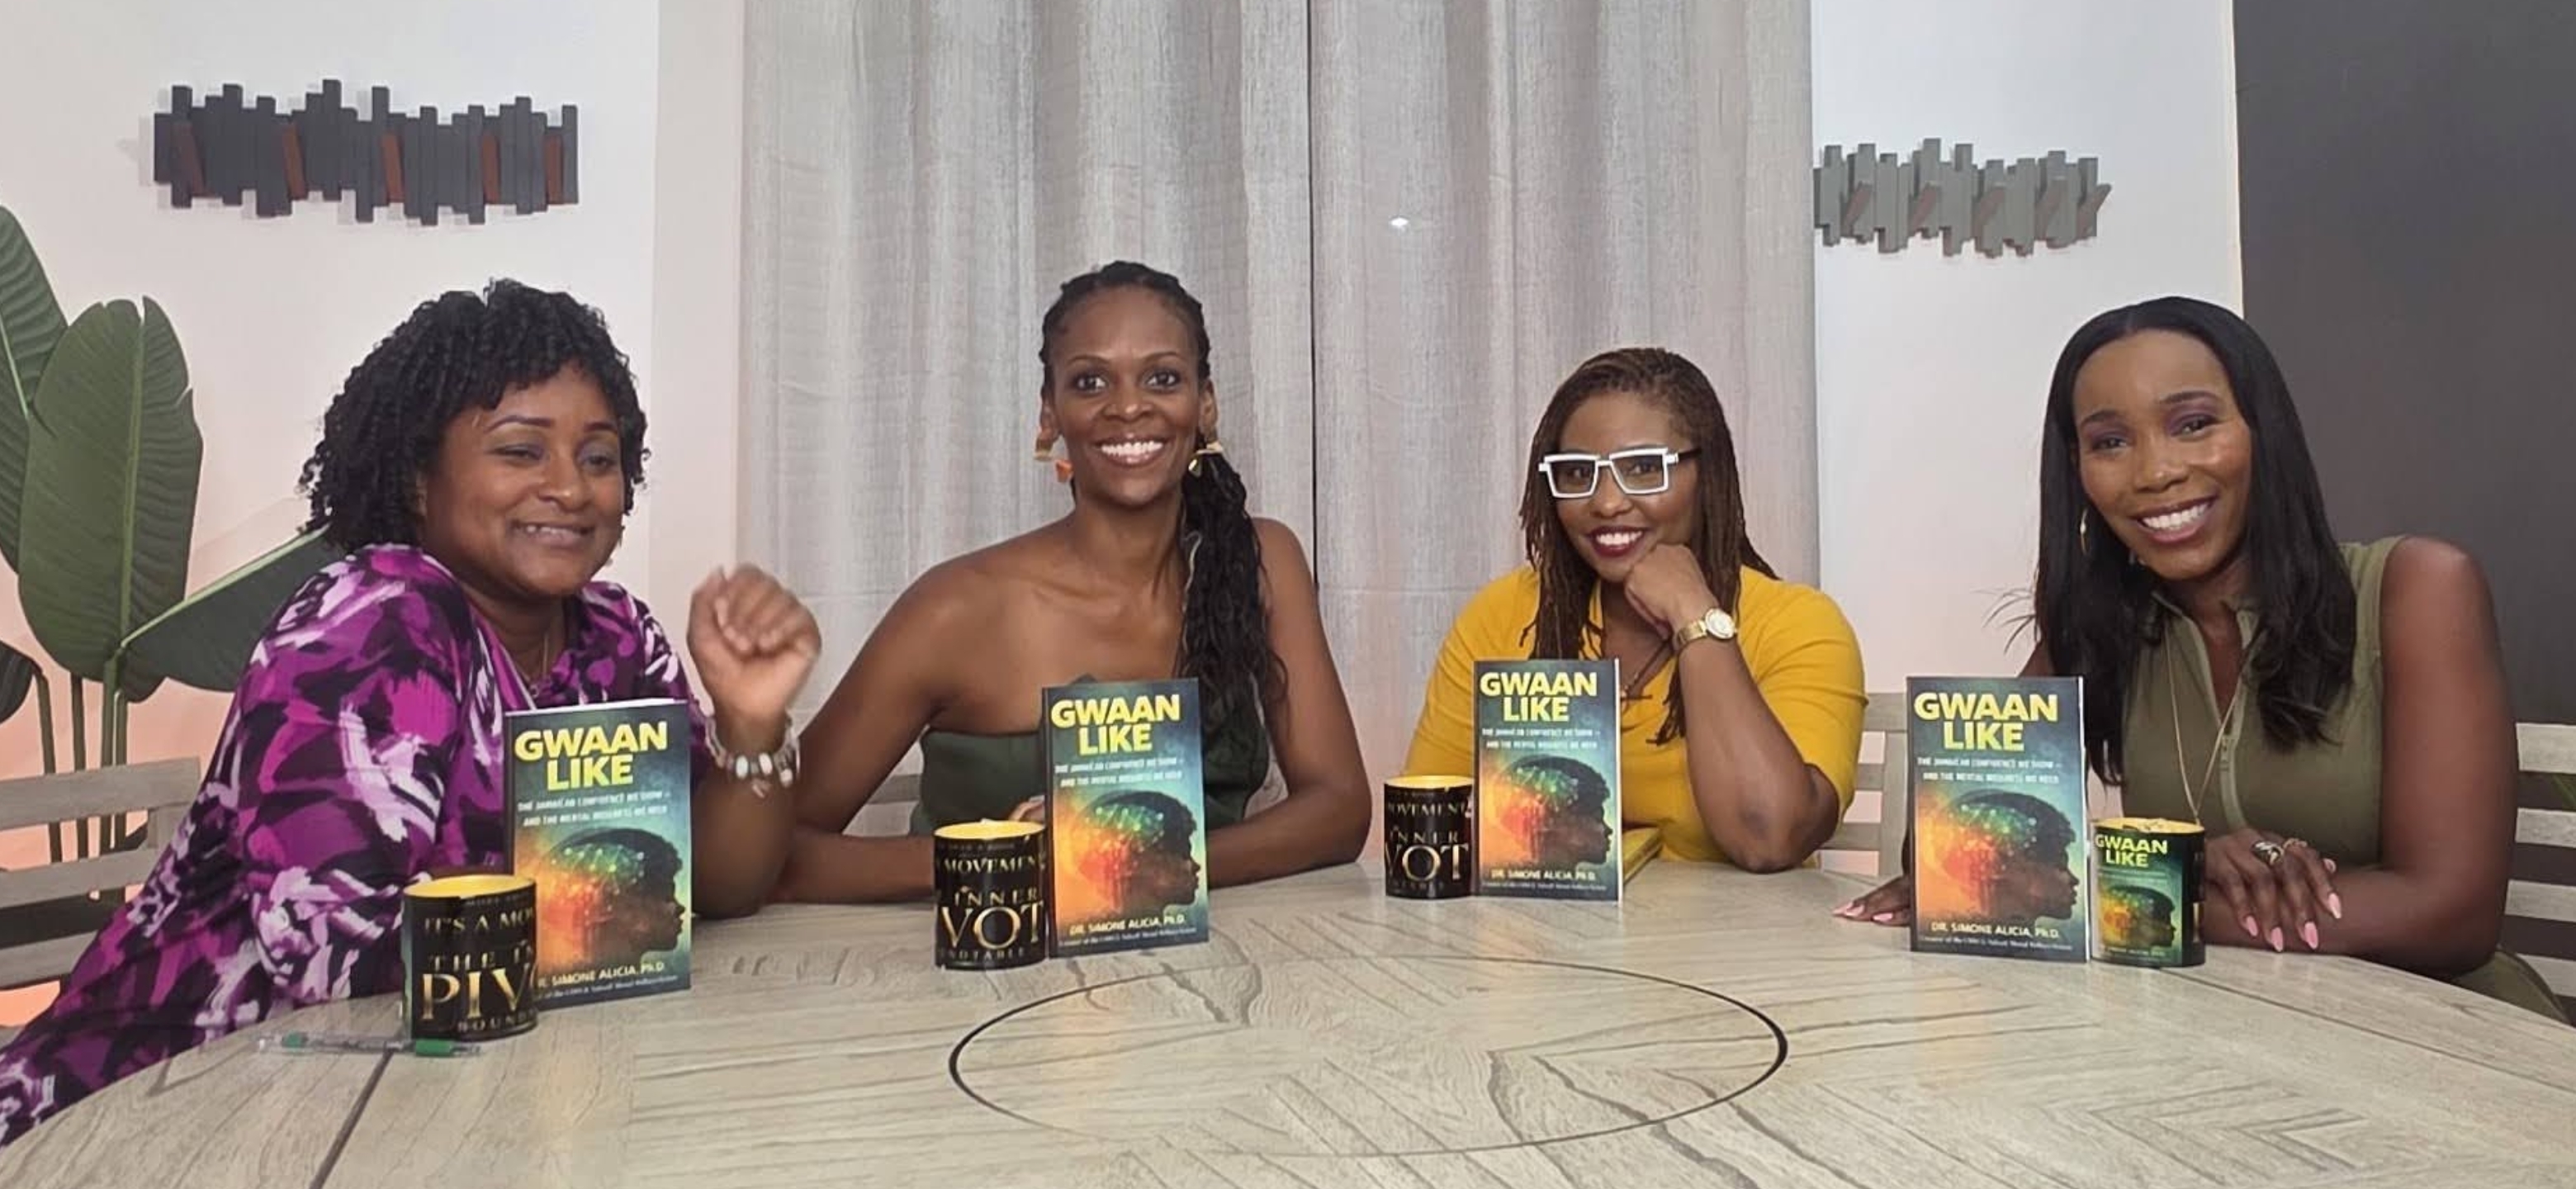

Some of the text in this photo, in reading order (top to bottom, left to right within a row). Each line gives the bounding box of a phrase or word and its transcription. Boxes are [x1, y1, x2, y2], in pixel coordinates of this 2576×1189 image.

[1480, 671, 1597, 697] GWAAN
[1050, 694, 1181, 728] GWAAN
[1503, 697, 1570, 722] LIKE
[1914, 692, 2057, 722] GWAAN
[514, 722, 667, 760] GWAAN
[1078, 723, 1153, 756] LIKE
[1944, 721, 2024, 751] LIKE
[547, 755, 632, 791] LIKE
[2095, 834, 2167, 855] GWAAN
[2106, 849, 2149, 867] LIKE
[954, 888, 1038, 906] INNER
[476, 915, 489, 930] A
[941, 900, 1044, 949] VOT
[1088, 920, 1125, 933] SIMONE
[1951, 922, 1992, 934] SIMONE
[429, 951, 495, 972] THE
[552, 970, 595, 986] SIMONE
[422, 963, 535, 1020] PIV
